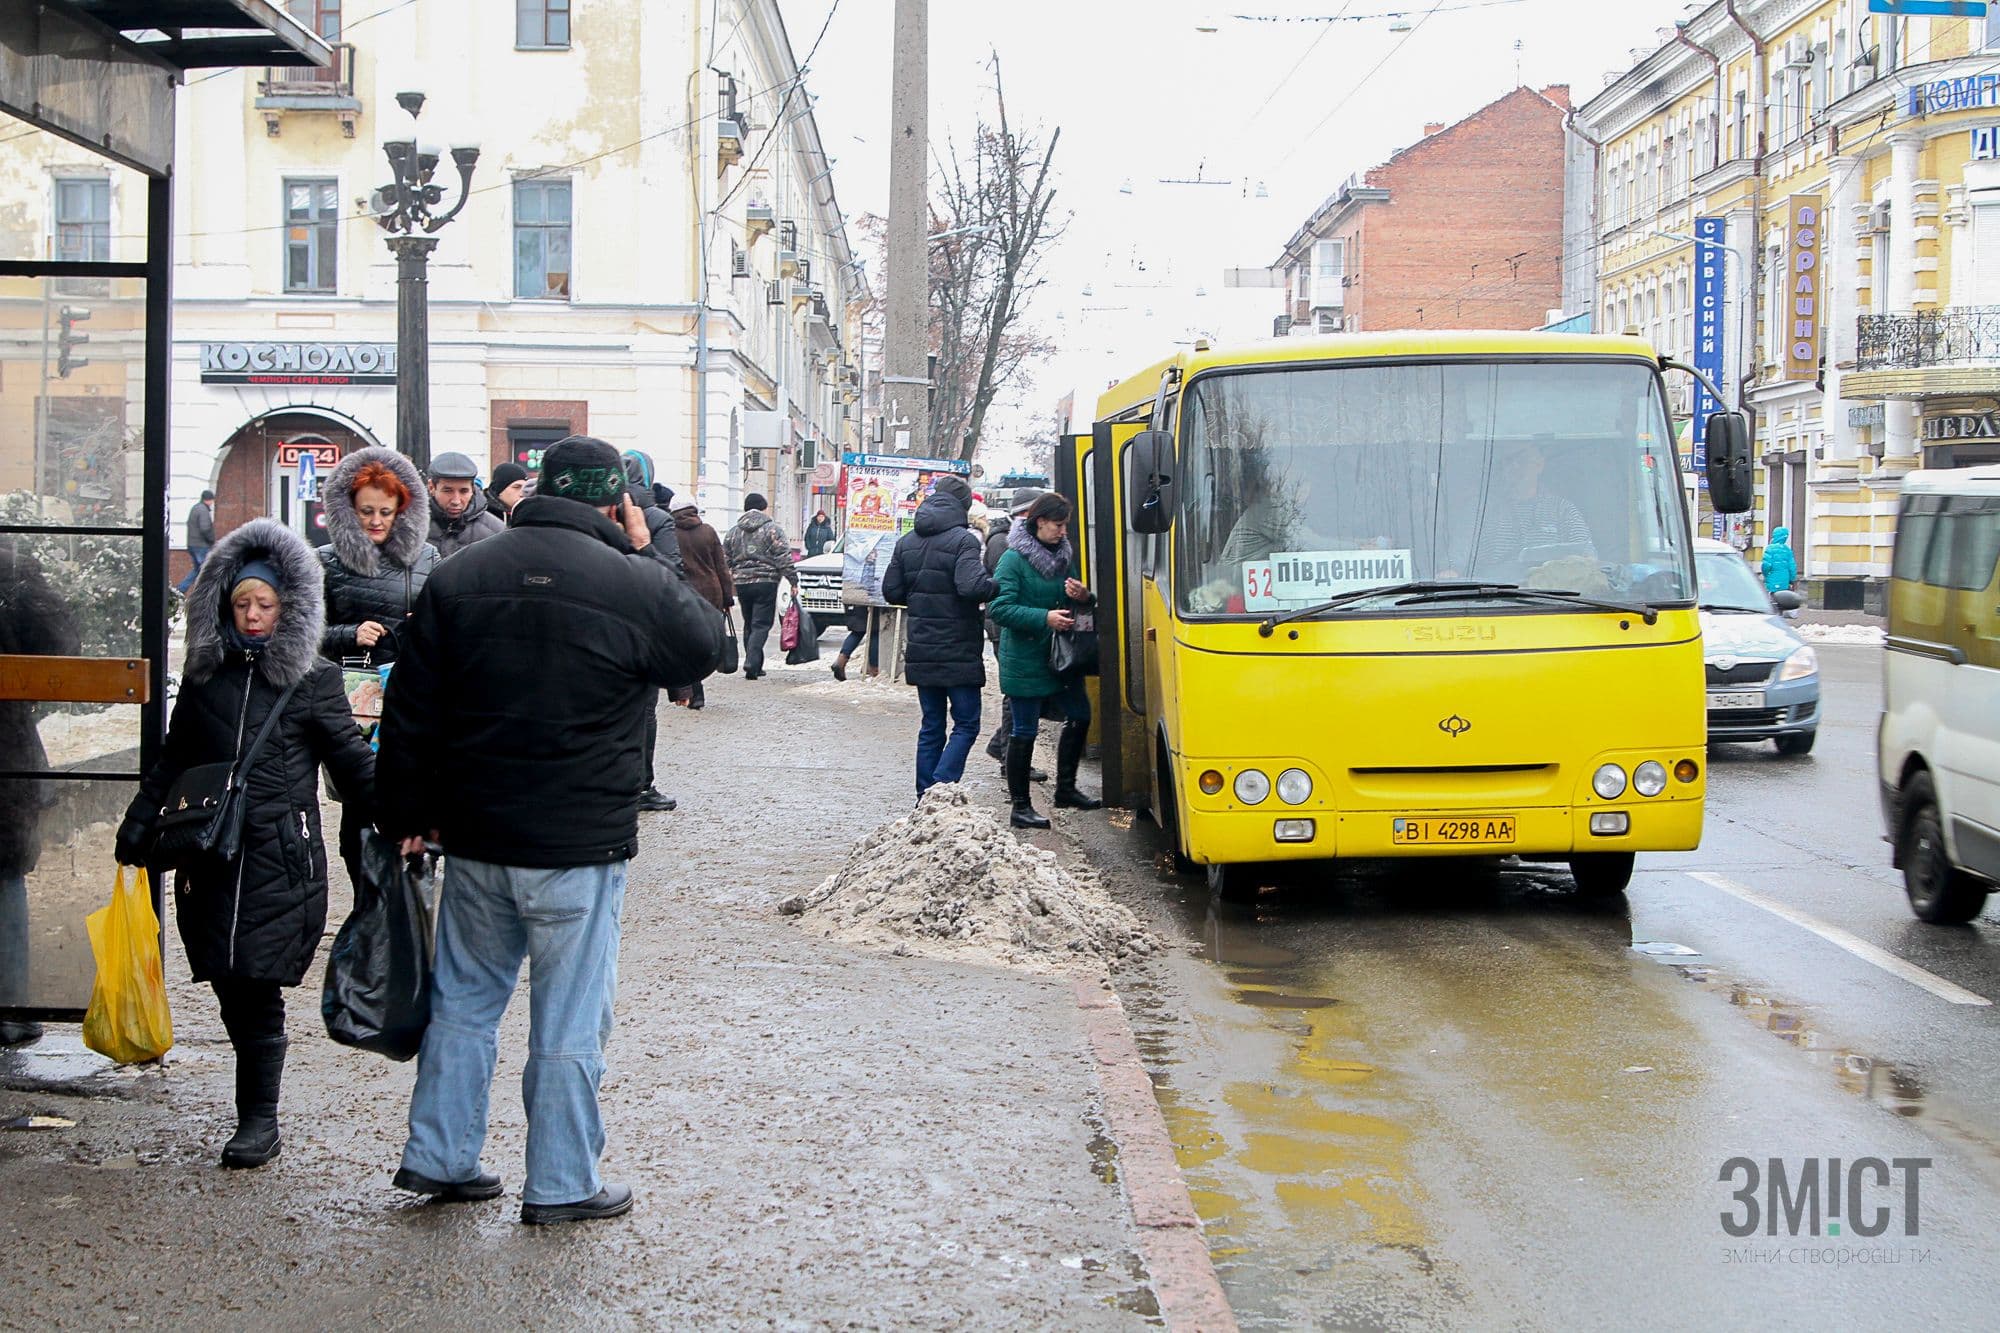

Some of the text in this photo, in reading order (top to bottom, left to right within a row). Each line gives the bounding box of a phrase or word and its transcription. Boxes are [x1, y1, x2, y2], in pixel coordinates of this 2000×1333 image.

[1924, 75, 2000, 113] КОМП
[1973, 128, 2000, 159] Д
[200, 343, 398, 373] КОСМОЛОТ
[1927, 416, 2000, 439] ПЕРЛ
[1407, 821, 1510, 840] BI 4298 AA
